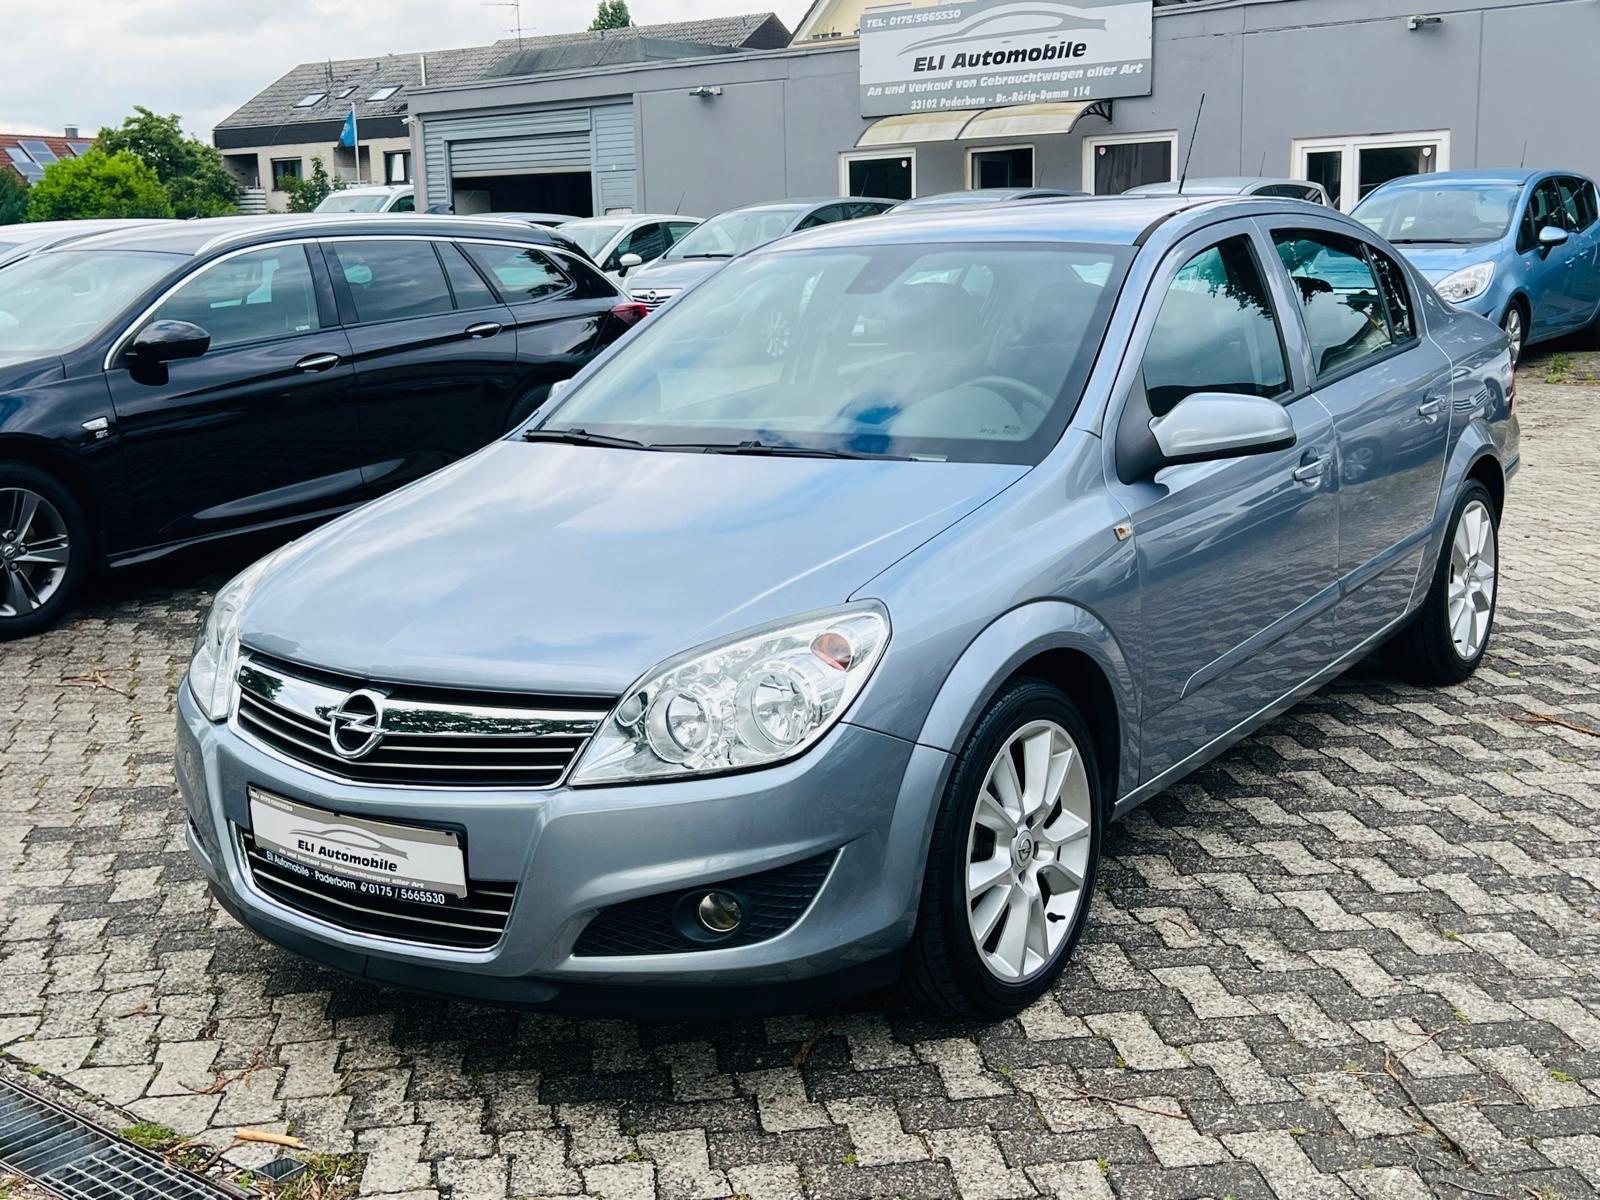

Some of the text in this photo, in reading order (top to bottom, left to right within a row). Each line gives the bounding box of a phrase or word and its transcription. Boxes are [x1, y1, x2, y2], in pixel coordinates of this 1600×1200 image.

[866, 9, 962, 28] TEL: 0175/5665530
[913, 41, 1087, 72] ELI Automobile
[867, 63, 1144, 96] An und Verkauf von Gebrauchtwagen aller Art
[910, 98, 937, 110] 33102
[939, 95, 986, 107] Paderborn
[1072, 86, 1091, 97] 114
[298, 839, 314, 852] ELI
[318, 846, 398, 872] Automobile
[274, 854, 310, 877] Automobile
[314, 870, 356, 890] Paderborn
[368, 884, 392, 897] 0175
[400, 888, 445, 905] 5665530
